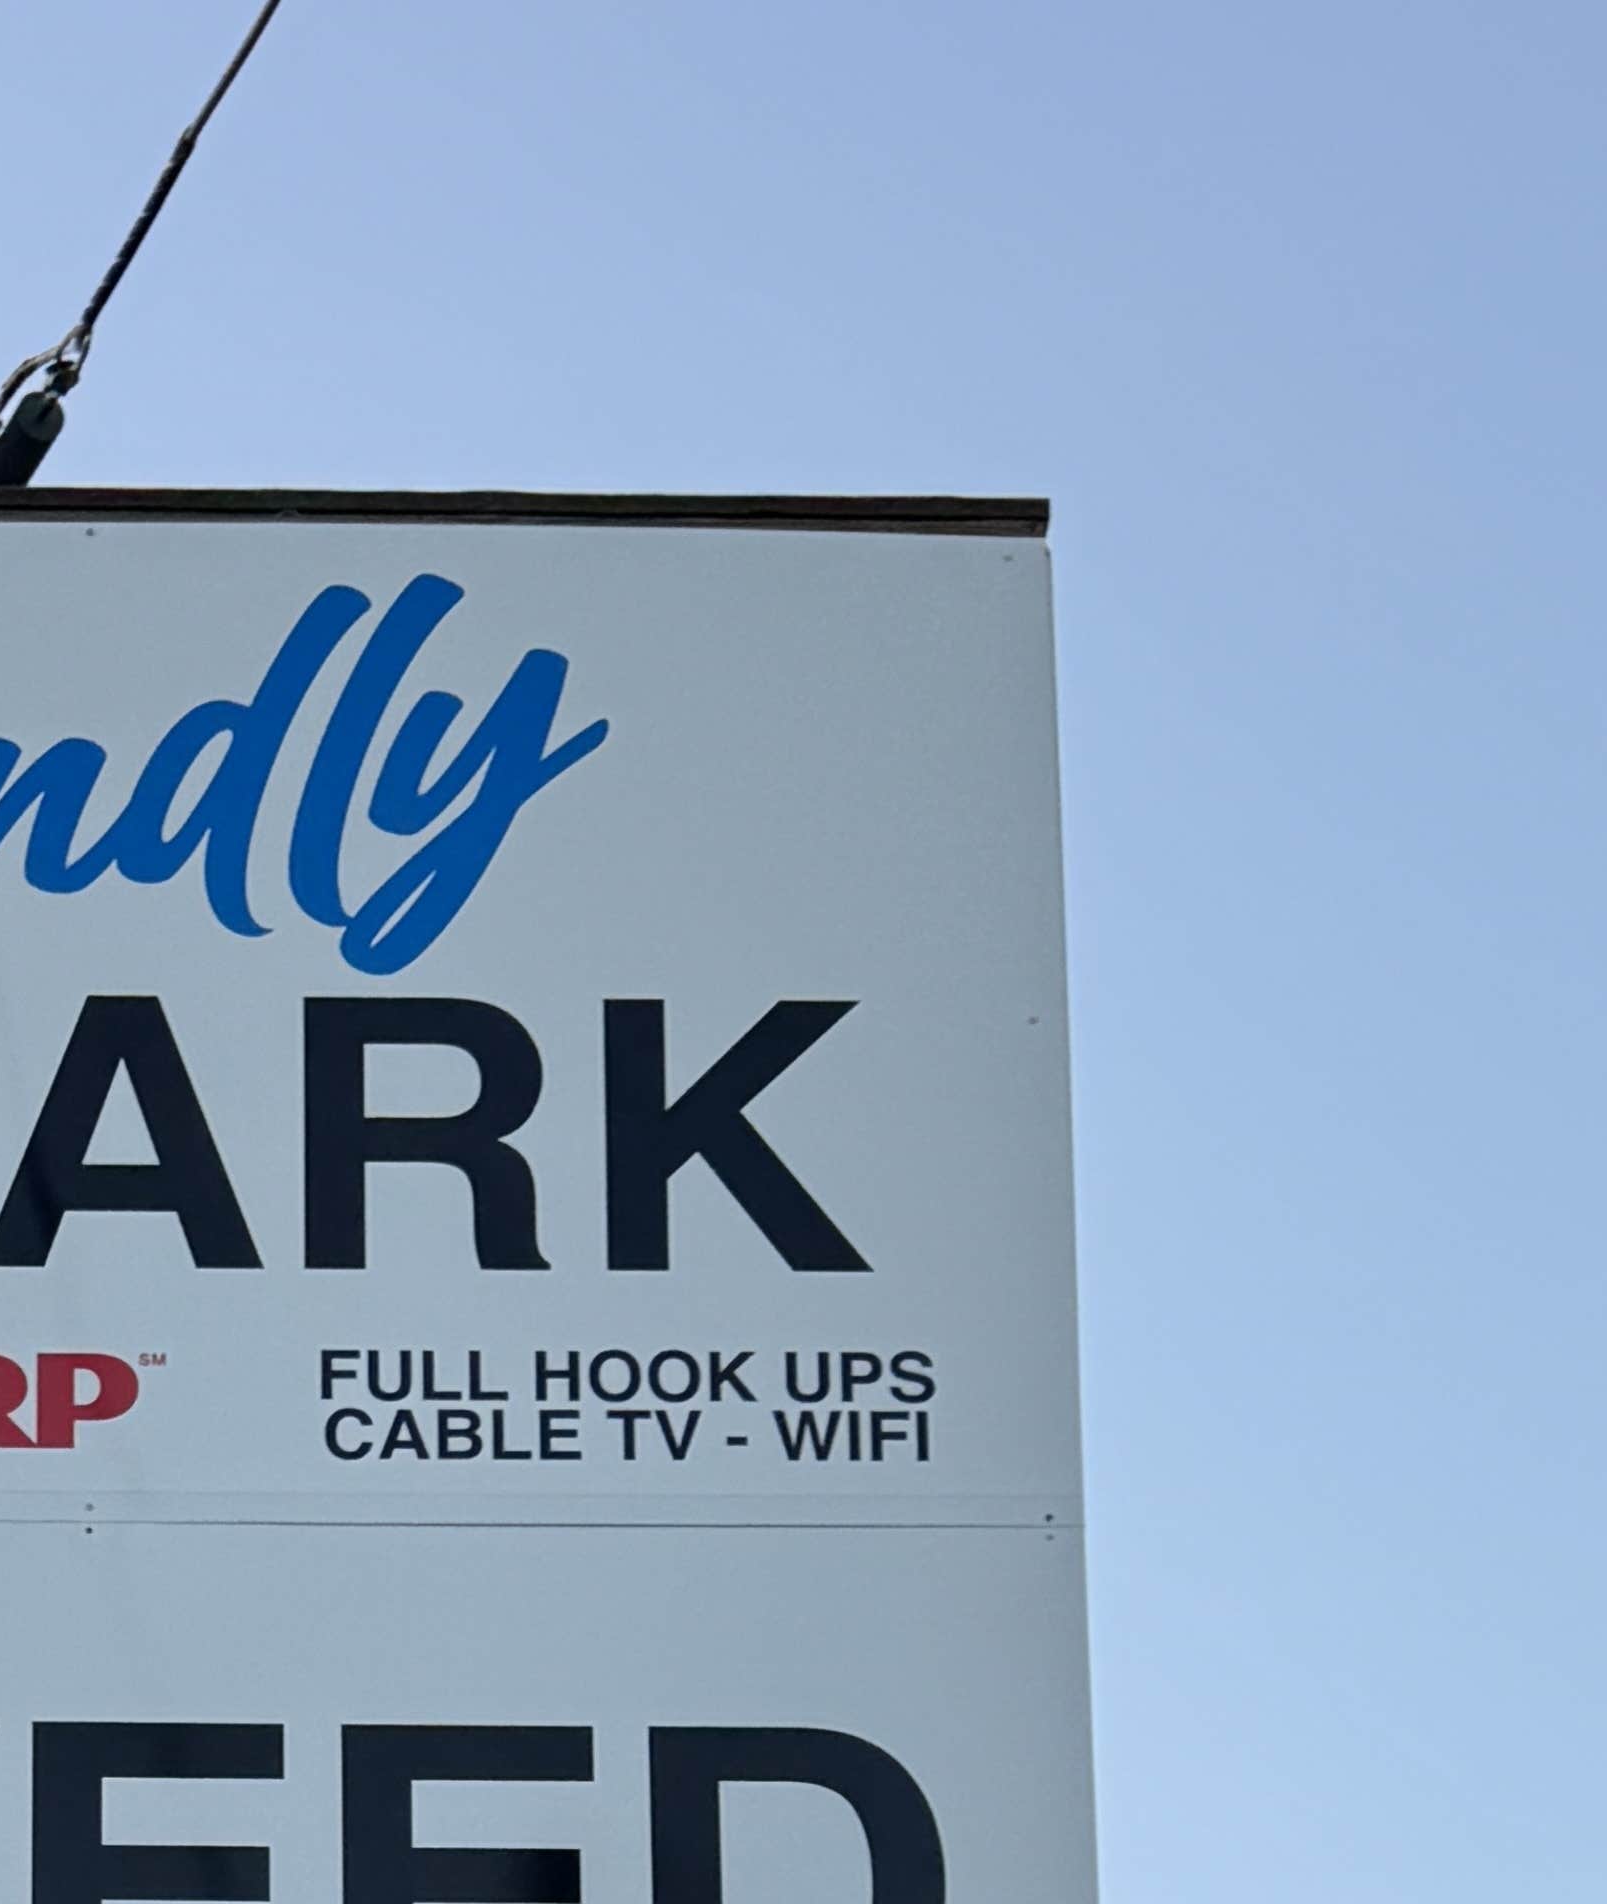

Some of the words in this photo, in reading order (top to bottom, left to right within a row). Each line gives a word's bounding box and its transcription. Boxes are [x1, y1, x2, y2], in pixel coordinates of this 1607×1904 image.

[320, 1349, 509, 1402] FULL
[534, 1350, 758, 1403] HOOK
[785, 1351, 936, 1404] UPS
[324, 1407, 582, 1461] CABLE
[607, 1409, 702, 1461] TV
[772, 1409, 930, 1462] WIFI
